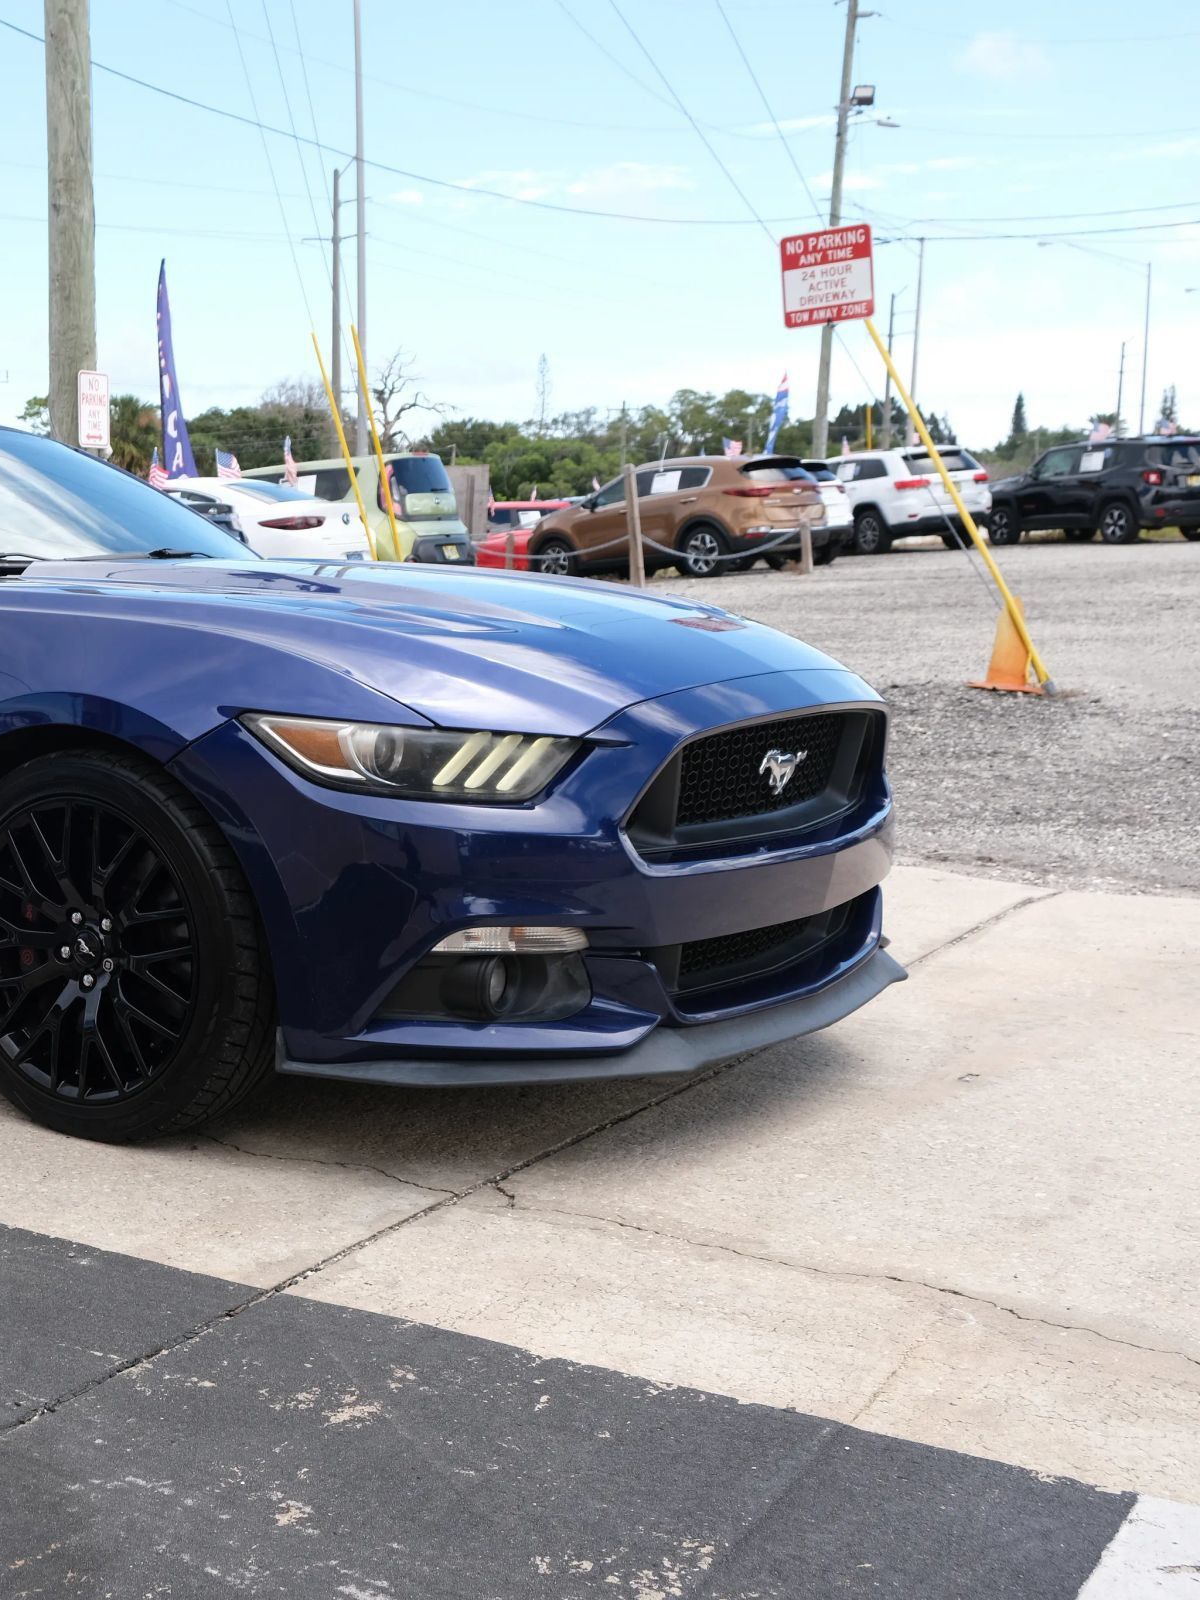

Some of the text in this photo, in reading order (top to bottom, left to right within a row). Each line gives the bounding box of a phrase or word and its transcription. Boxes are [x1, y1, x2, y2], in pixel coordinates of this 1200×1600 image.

[785, 229, 866, 256] NO PARKING
[798, 246, 854, 266] ANY TIME
[801, 264, 853, 282] 24 HOUR
[808, 277, 848, 292] ACTIVE
[799, 288, 856, 306] DRIVEWAY
[790, 302, 868, 324] TOW AWAY ZONE
[88, 377, 100, 391] NO
[81, 392, 106, 407] PARKING
